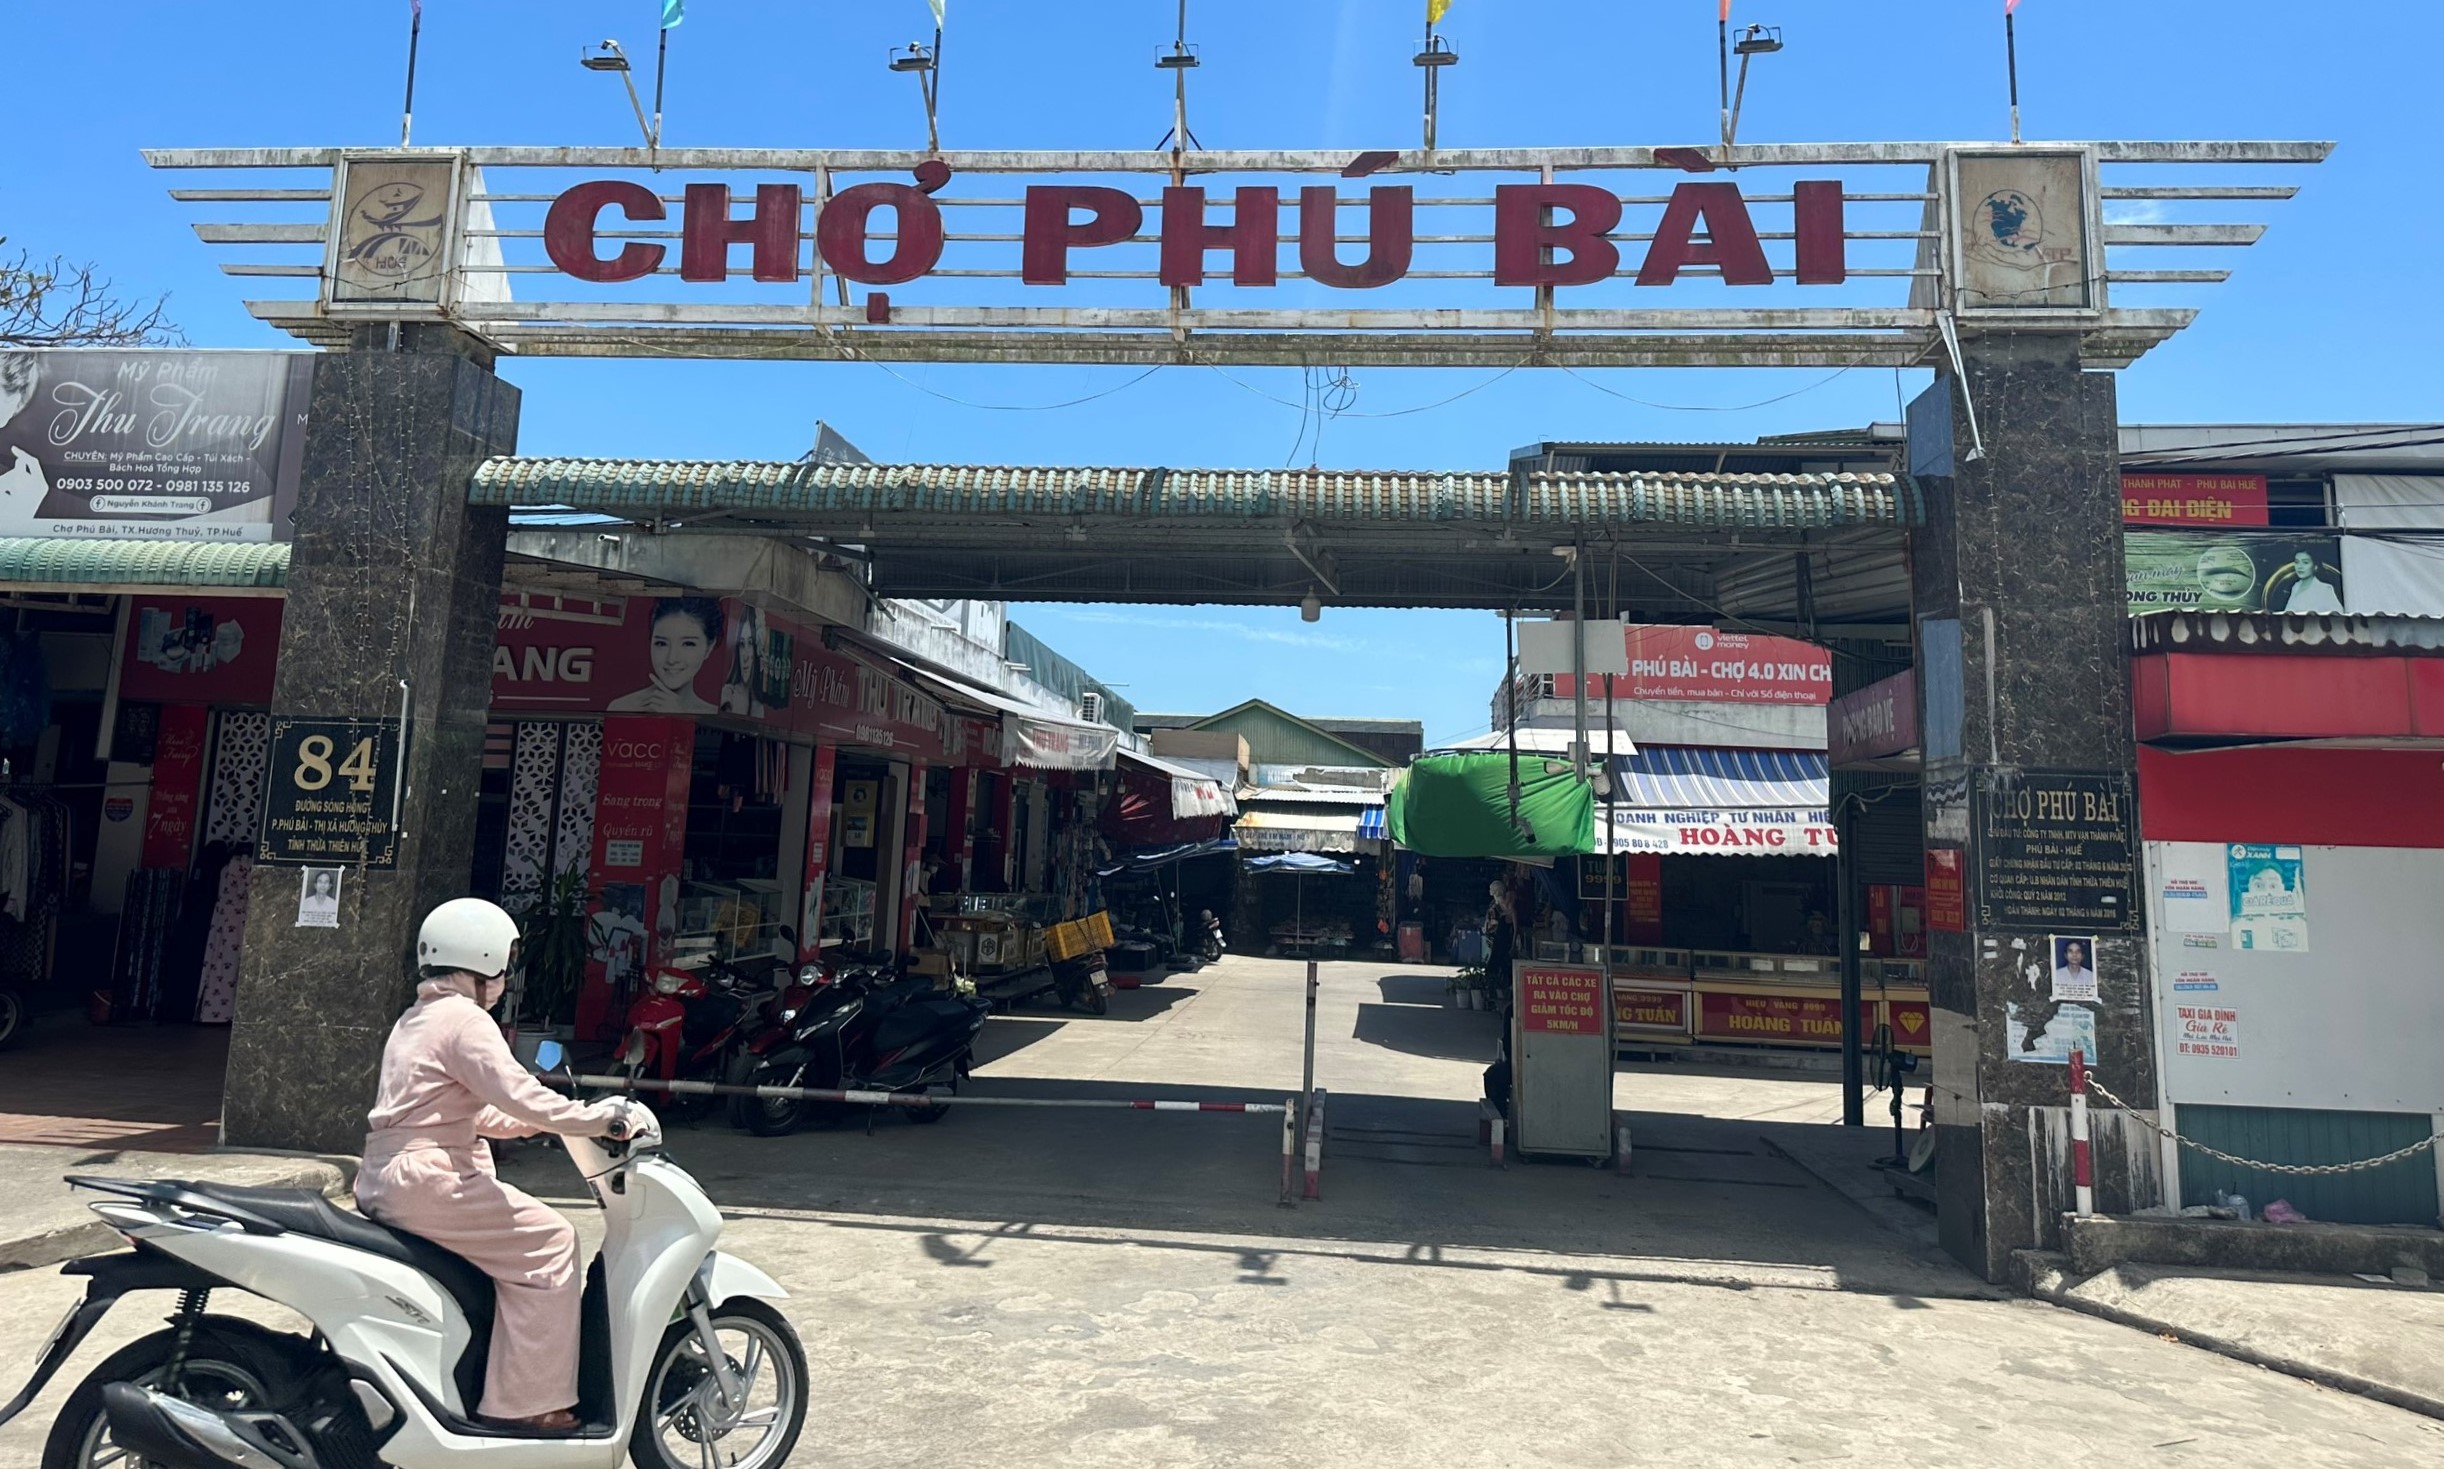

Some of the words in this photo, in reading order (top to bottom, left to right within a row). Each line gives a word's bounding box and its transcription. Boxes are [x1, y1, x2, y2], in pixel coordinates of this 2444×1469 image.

[543, 160, 952, 325] CHỢ
[1021, 150, 1414, 289] PHÚ
[1493, 147, 1846, 287] BÀI
[117, 360, 151, 382] Mỹ
[156, 356, 219, 379] Phẩm
[48, 381, 137, 446] Thu
[146, 382, 276, 451] Trang
[155, 453, 174, 462] Cao
[204, 453, 218, 462] Túi
[221, 453, 243, 463] Xách
[109, 463, 133, 472] Bách
[182, 465, 202, 475] Hợp
[56, 478, 93, 491] 0903
[96, 479, 124, 491] 500
[127, 479, 154, 492] 072
[166, 479, 198, 492] 0981
[202, 481, 224, 492] 135
[228, 481, 250, 493] 126
[142, 499, 168, 509] Khánh
[170, 501, 194, 511] Trang
[76, 525, 95, 534] Phú
[207, 526, 243, 537] TP.Huế
[2162, 586, 2203, 603] THỦY
[1717, 634, 1748, 642] viettel
[1717, 642, 1749, 650] money
[492, 645, 594, 683] ANG
[1632, 655, 1667, 677] PHÚ
[1669, 654, 1697, 678] BÀI
[1711, 659, 1745, 683] CHỢ
[1748, 663, 1773, 680] 4.0
[1777, 664, 1806, 680] XIN
[856, 664, 890, 720] THU
[1687, 689, 1706, 697] mua
[1731, 688, 1745, 697] Chỉ
[1746, 689, 1759, 698] với
[1760, 688, 1773, 698] Số
[1774, 690, 1793, 700] điện
[1794, 690, 1817, 701] thoại
[293, 735, 377, 791] 84
[295, 797, 322, 812] ĐƯỜNG
[1991, 785, 2032, 828] CHỢ
[2036, 781, 2077, 822] PHÚ
[2083, 782, 2120, 822] BÀI
[271, 816, 295, 831] P.PHÚ
[1615, 811, 1657, 824] OANH
[1664, 811, 1720, 826] NGHIỆP
[1729, 810, 1751, 824] TƯ
[1752, 810, 1797, 823] NHÂN
[1679, 822, 1786, 846] HOÀNG
[1613, 838, 1630, 848] 905
[1632, 839, 1650, 848] 808
[1653, 839, 1669, 849] 428
[2026, 841, 2043, 854] PHÚ
[2065, 842, 2083, 855] HUẾ
[1584, 873, 1622, 885] 999
[1526, 972, 1544, 985] TẤT
[1545, 973, 1560, 986] CẢ
[1562, 974, 1582, 987] CÁC
[1584, 978, 1597, 988] XE
[1533, 990, 1547, 1000] RA
[1548, 988, 1568, 1000] VÀO
[1570, 991, 1591, 1004] CHỢ
[1531, 1001, 1557, 1014] GIẢM
[1559, 1002, 1578, 1016] TỐC
[1580, 1004, 1594, 1018] ĐỘ
[1635, 1004, 1677, 1023] TUẤN
[2177, 1007, 2196, 1019] TAXI
[2197, 1008, 2212, 1020] GIA
[2214, 1008, 2236, 1022] ĐÌNH
[1546, 1019, 1579, 1030] 5KM/H
[1728, 1010, 1791, 1033] HOÀNG
[2191, 1043, 2210, 1055] 0935
[2211, 1044, 2237, 1057] 520101
